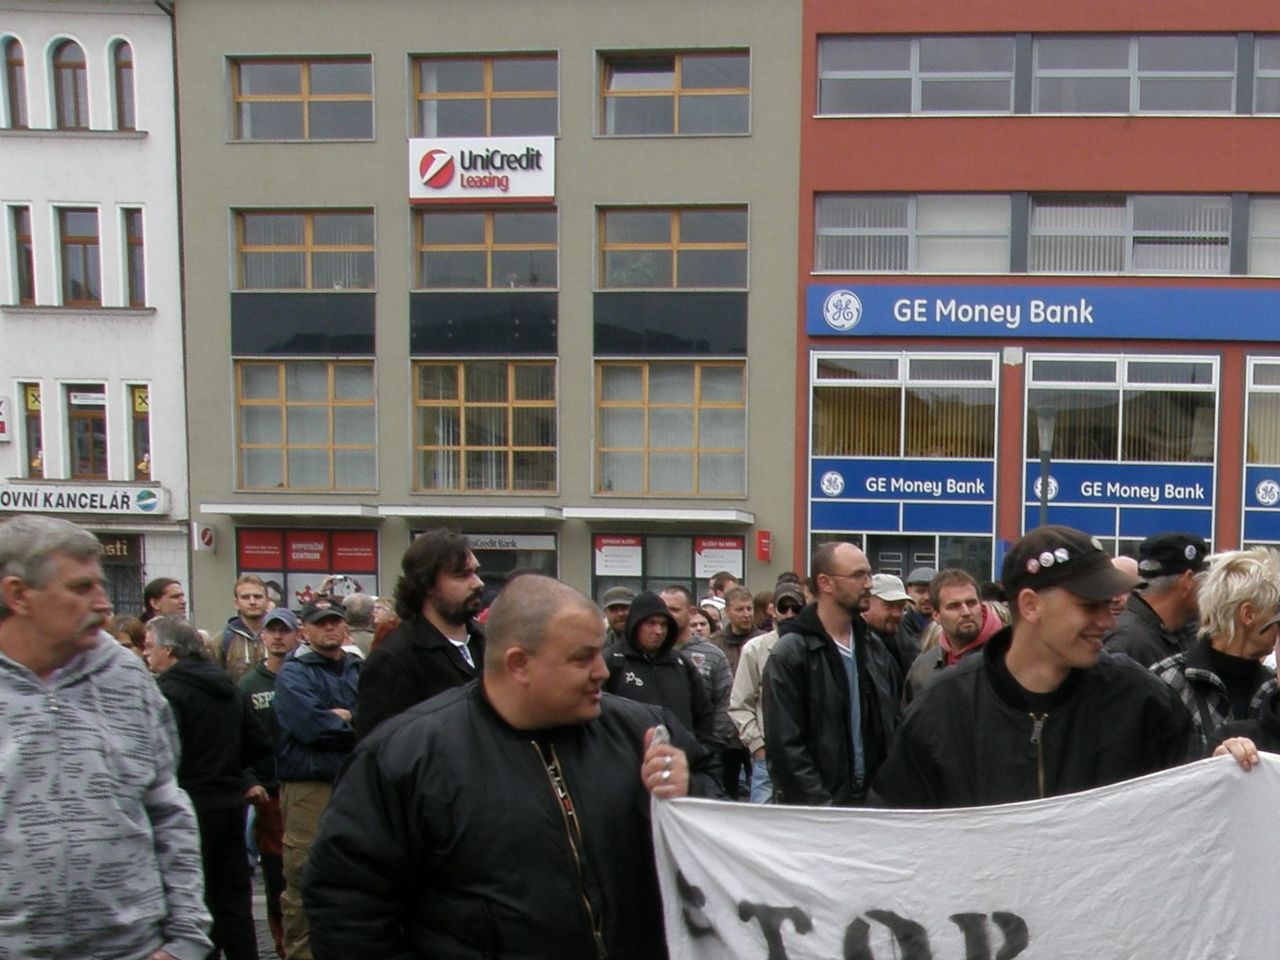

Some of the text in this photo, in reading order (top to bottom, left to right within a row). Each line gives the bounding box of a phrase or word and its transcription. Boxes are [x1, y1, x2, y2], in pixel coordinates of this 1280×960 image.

[460, 146, 543, 171] UniCredit
[460, 172, 509, 192] Leasing
[893, 298, 1094, 329] GE Money Bank
[865, 477, 985, 496] GE Money Bank
[1080, 481, 1205, 501] GE Money Bank
[43, 490, 131, 510] KANCELÁŘ
